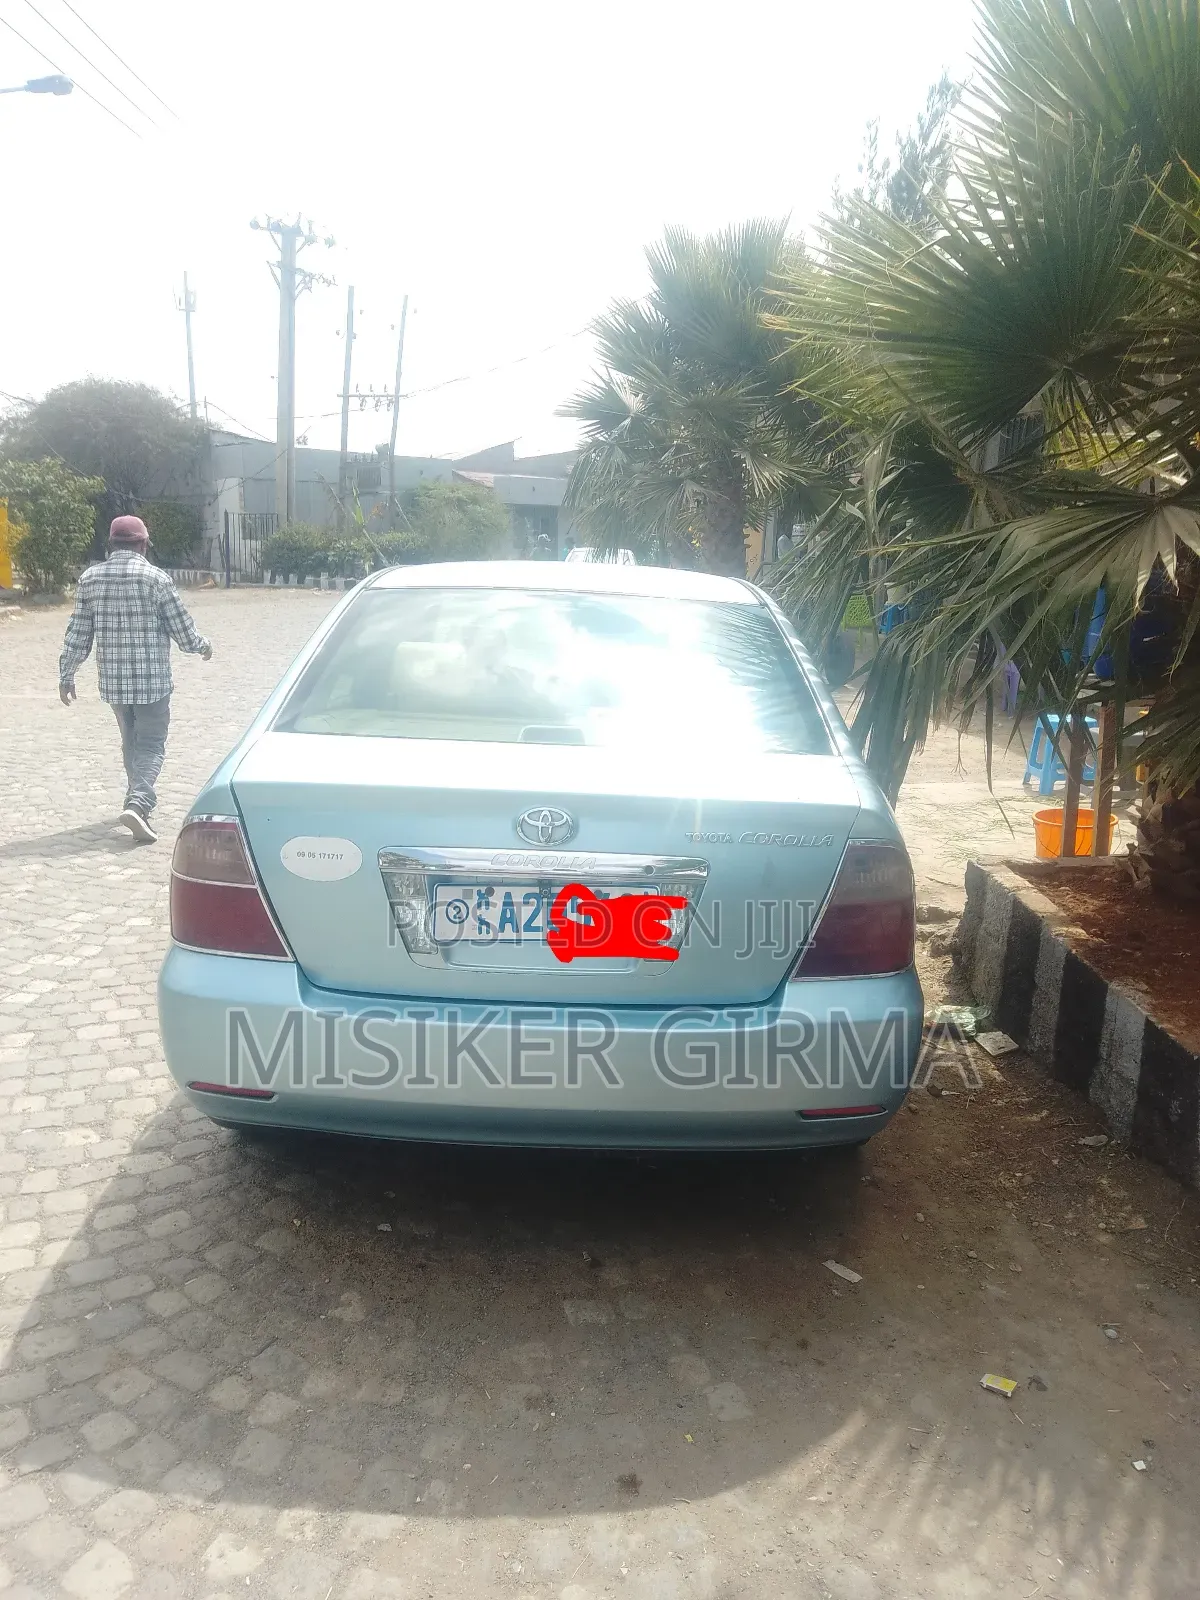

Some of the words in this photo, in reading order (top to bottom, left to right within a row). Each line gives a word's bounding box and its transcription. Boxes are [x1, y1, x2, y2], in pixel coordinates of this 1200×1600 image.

[685, 832, 731, 843] TOYOTA
[739, 831, 834, 846] COROLLA
[491, 853, 597, 869] COROLLA
